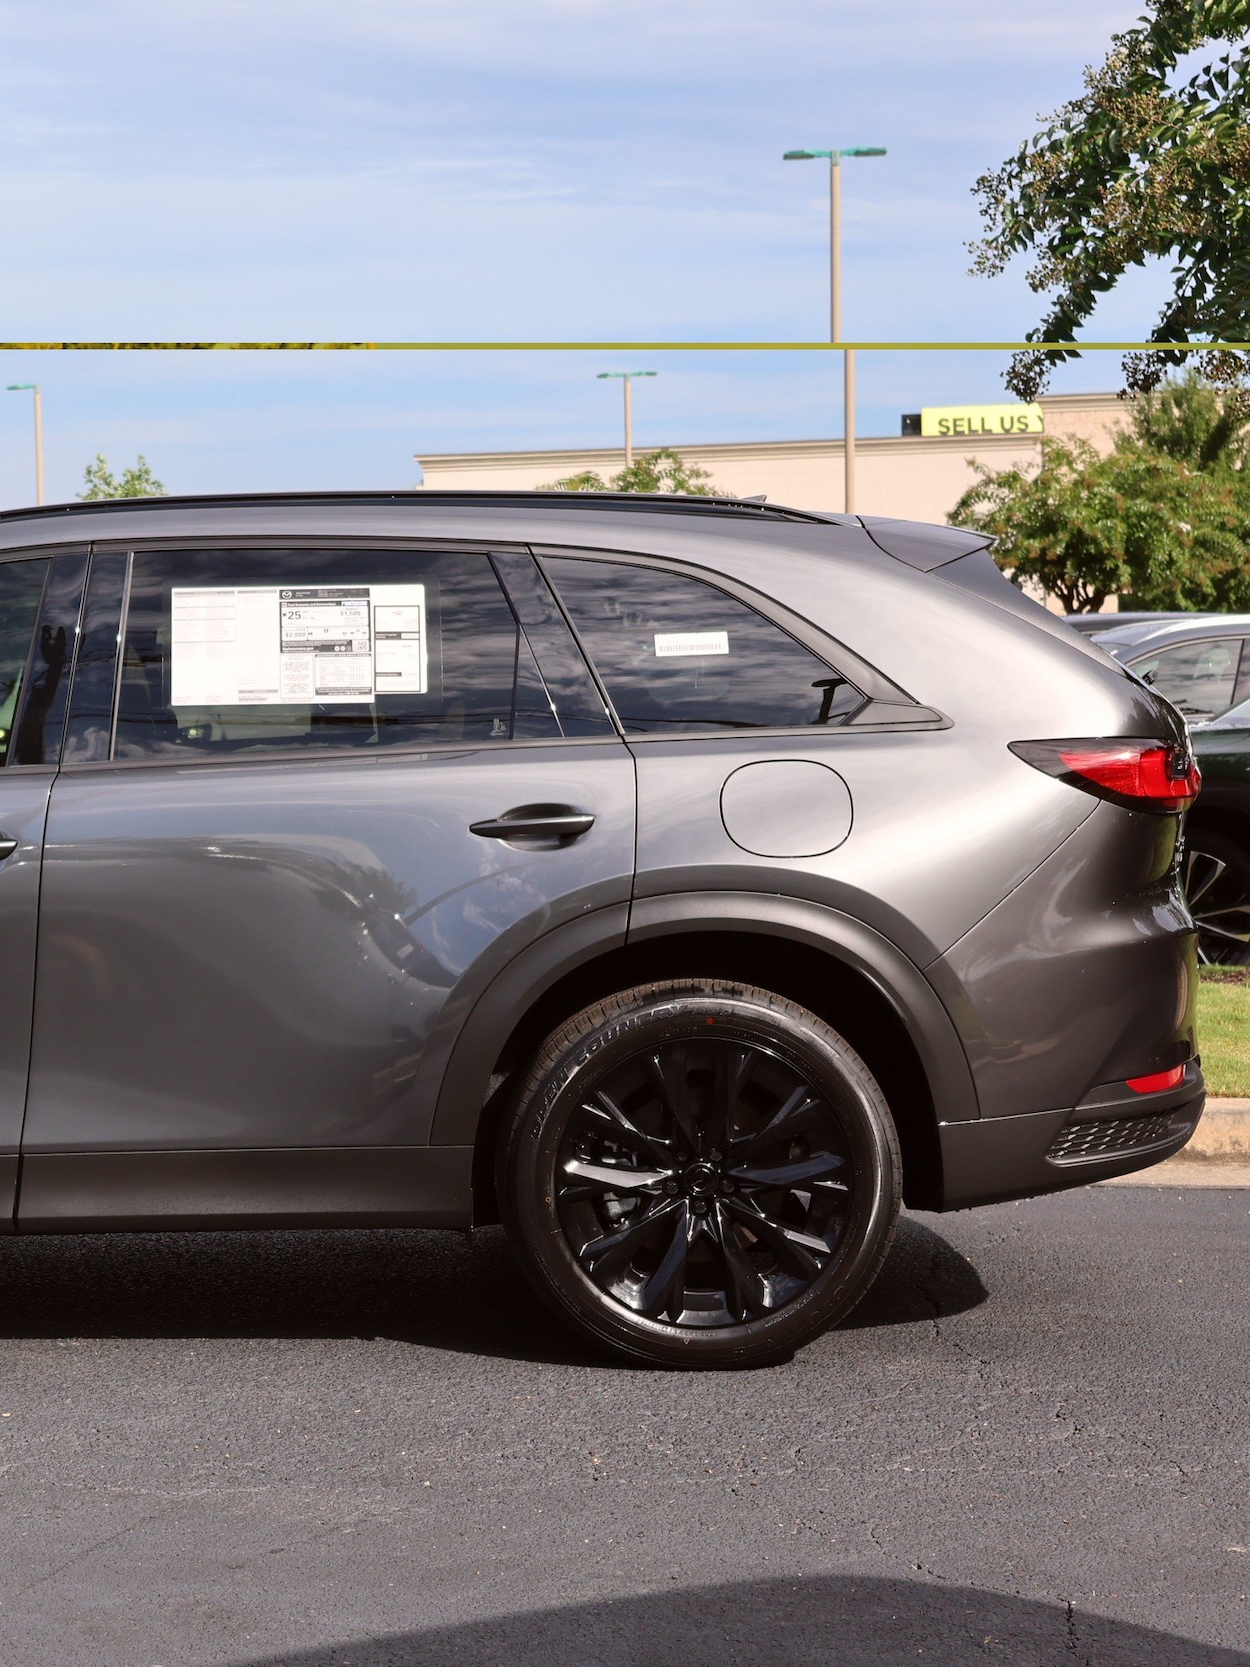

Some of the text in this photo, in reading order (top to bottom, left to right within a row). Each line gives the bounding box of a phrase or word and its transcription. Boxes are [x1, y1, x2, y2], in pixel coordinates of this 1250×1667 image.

[938, 416, 993, 435] SELL
[1001, 415, 1029, 433] US
[288, 611, 302, 620] 25
